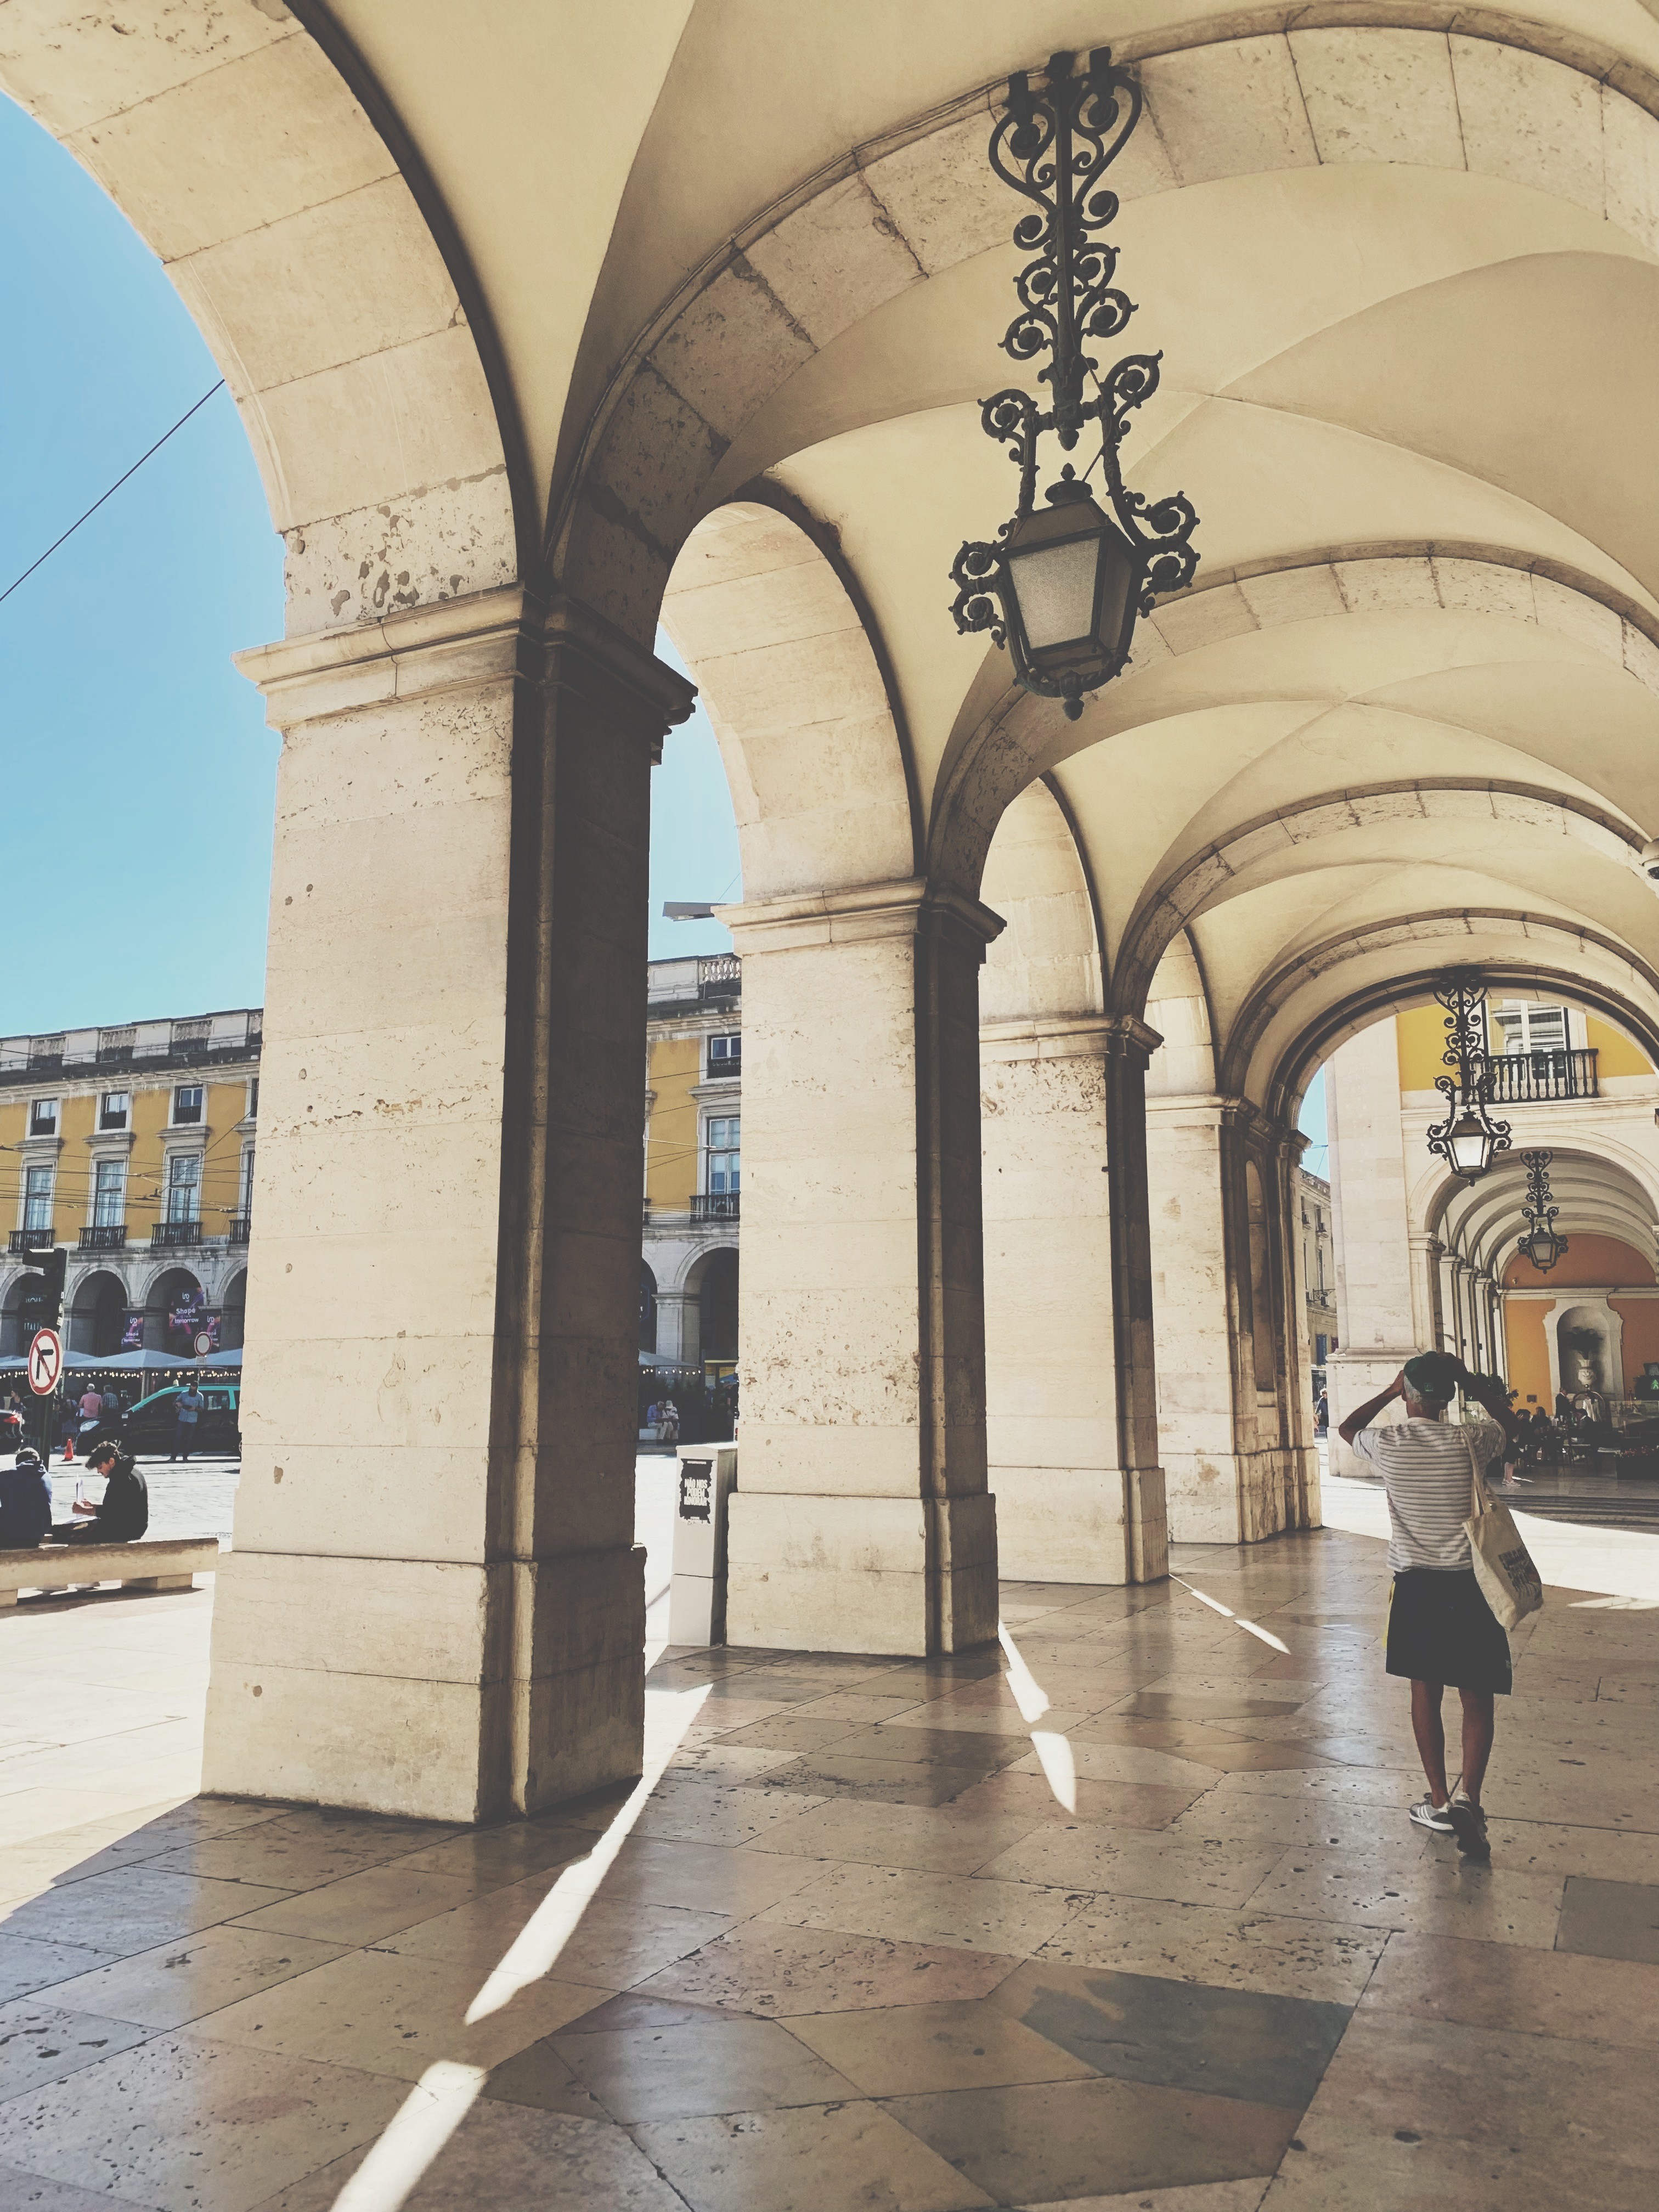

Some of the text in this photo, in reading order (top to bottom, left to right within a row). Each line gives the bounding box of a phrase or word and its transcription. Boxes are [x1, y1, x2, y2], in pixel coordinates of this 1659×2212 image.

[684, 1477, 708, 1489] NÃO NOS
[687, 1487, 706, 1497] PODEM
[684, 1496, 707, 1506] IGNORAR
